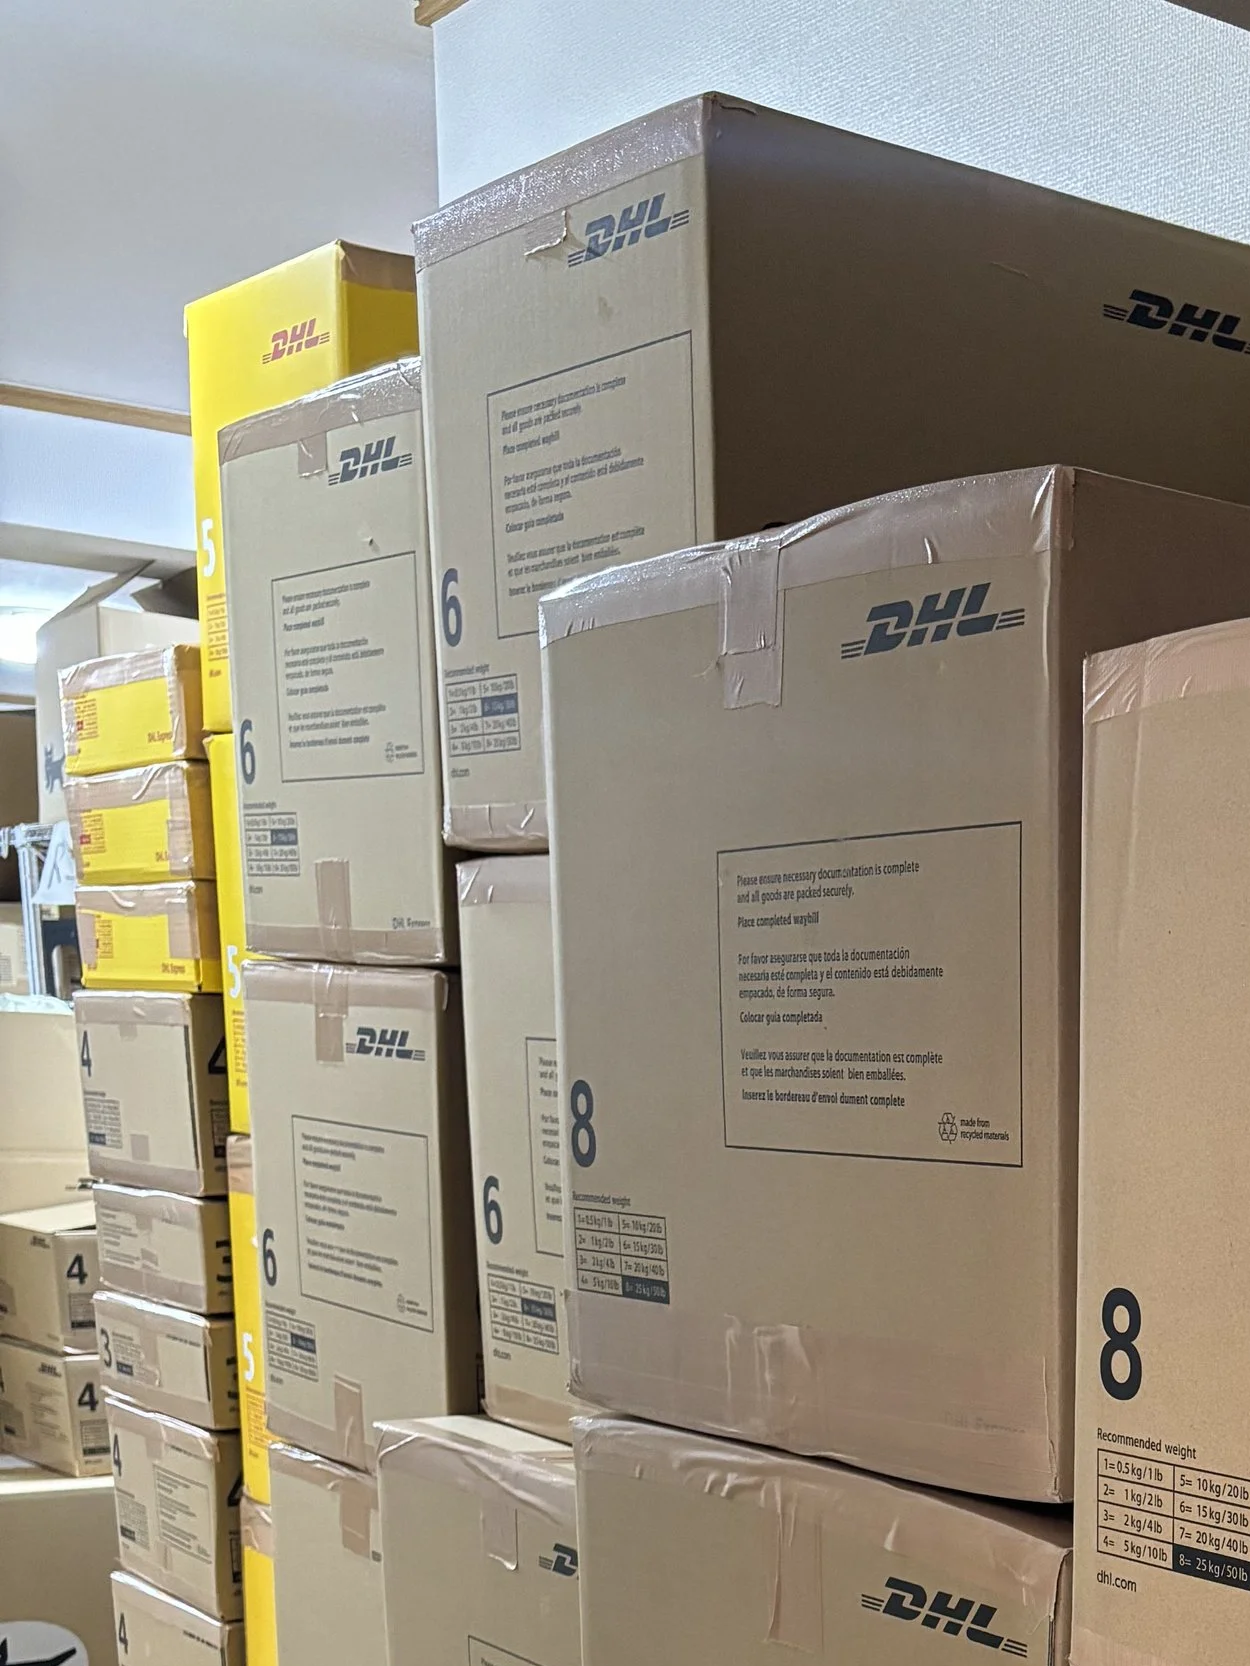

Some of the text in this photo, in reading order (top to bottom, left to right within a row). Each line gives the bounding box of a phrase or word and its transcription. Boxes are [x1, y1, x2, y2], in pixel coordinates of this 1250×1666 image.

[582, 194, 672, 262] DHL
[269, 318, 321, 362] DHL
[1126, 289, 1247, 352] DHL
[338, 436, 401, 485] DHL
[202, 518, 216, 578] 5
[441, 568, 462, 648] 6
[864, 581, 999, 656] DHL
[240, 719, 256, 785] 6
[226, 945, 240, 997] 5
[80, 1030, 92, 1078] 4
[355, 1026, 413, 1060] DHL
[569, 1079, 596, 1168] 8
[483, 1175, 503, 1245] 6
[66, 1253, 88, 1285] 4
[263, 1228, 277, 1287] 6
[243, 1332, 255, 1382] 5
[1100, 1287, 1142, 1401] 8
[78, 1382, 99, 1412] 4
[112, 1433, 122, 1477] 4
[1097, 1428, 1196, 1459] Recommended weight
[1097, 1570, 1137, 1592] dhl.com
[118, 1612, 128, 1655] 4
[883, 1577, 1004, 1649] DHL
